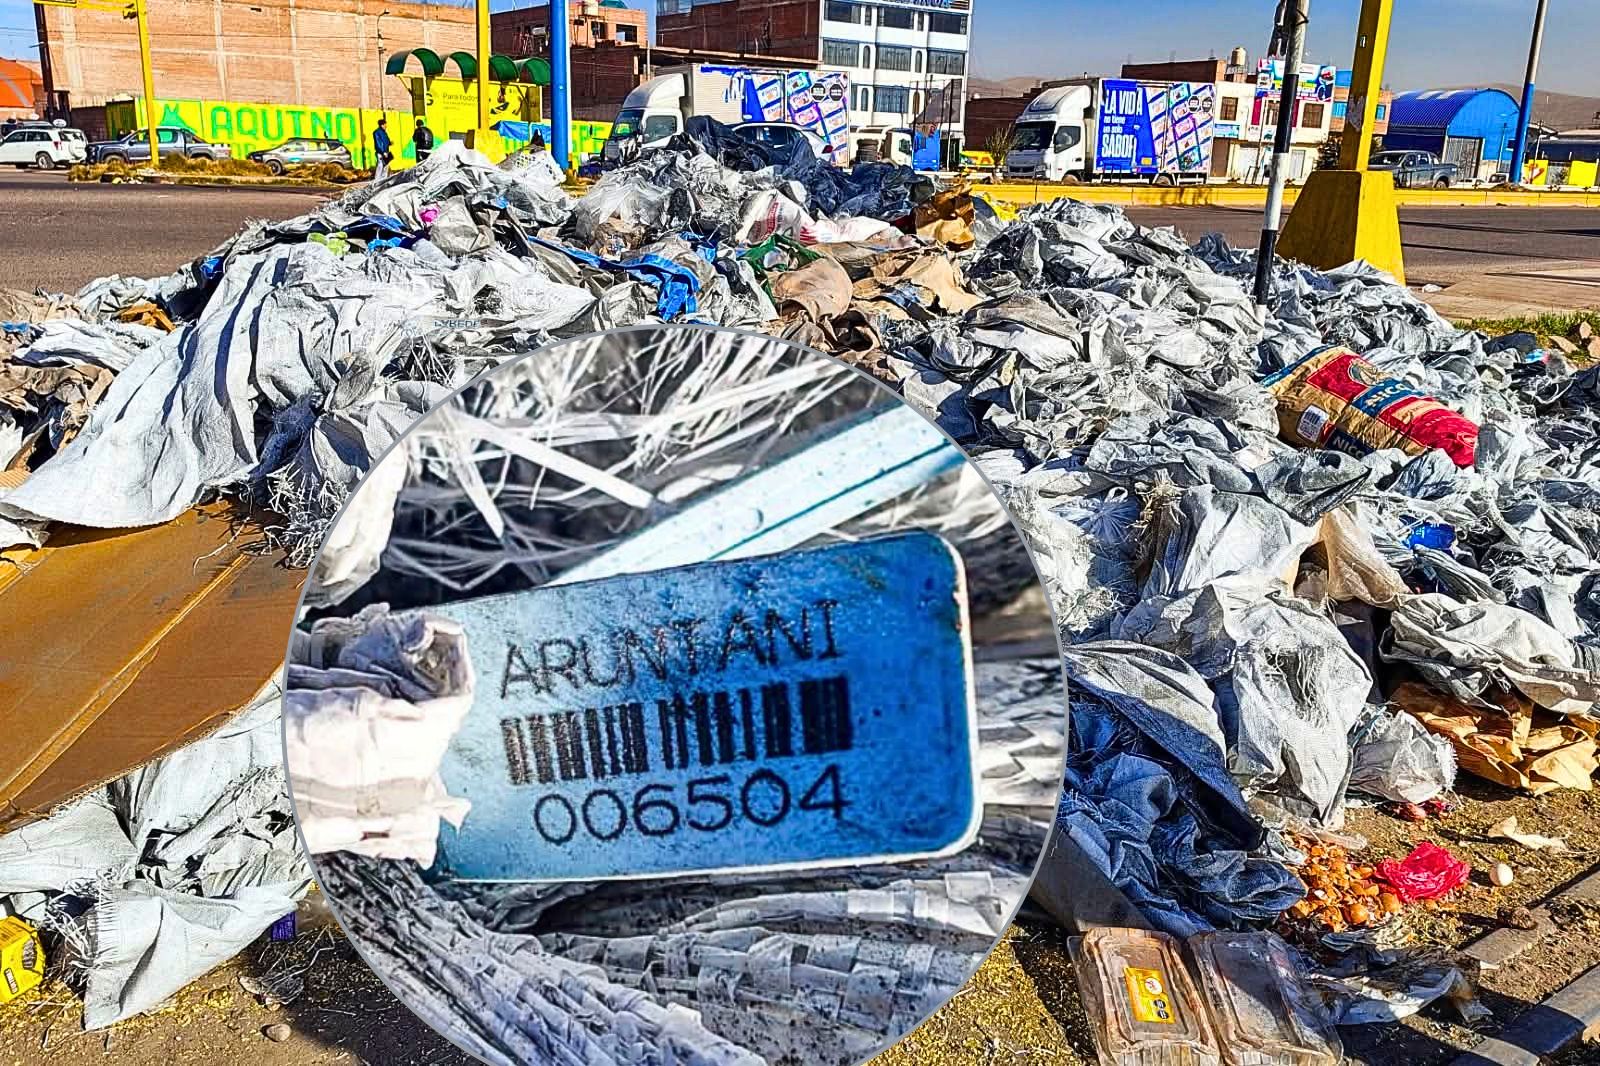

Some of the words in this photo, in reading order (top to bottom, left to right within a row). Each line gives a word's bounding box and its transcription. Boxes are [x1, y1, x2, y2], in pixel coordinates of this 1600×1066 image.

[1104, 89, 1117, 114] LA
[1118, 88, 1143, 116] VIDA
[499, 600, 839, 699] ARUNTANI
[534, 764, 852, 845] 006504
